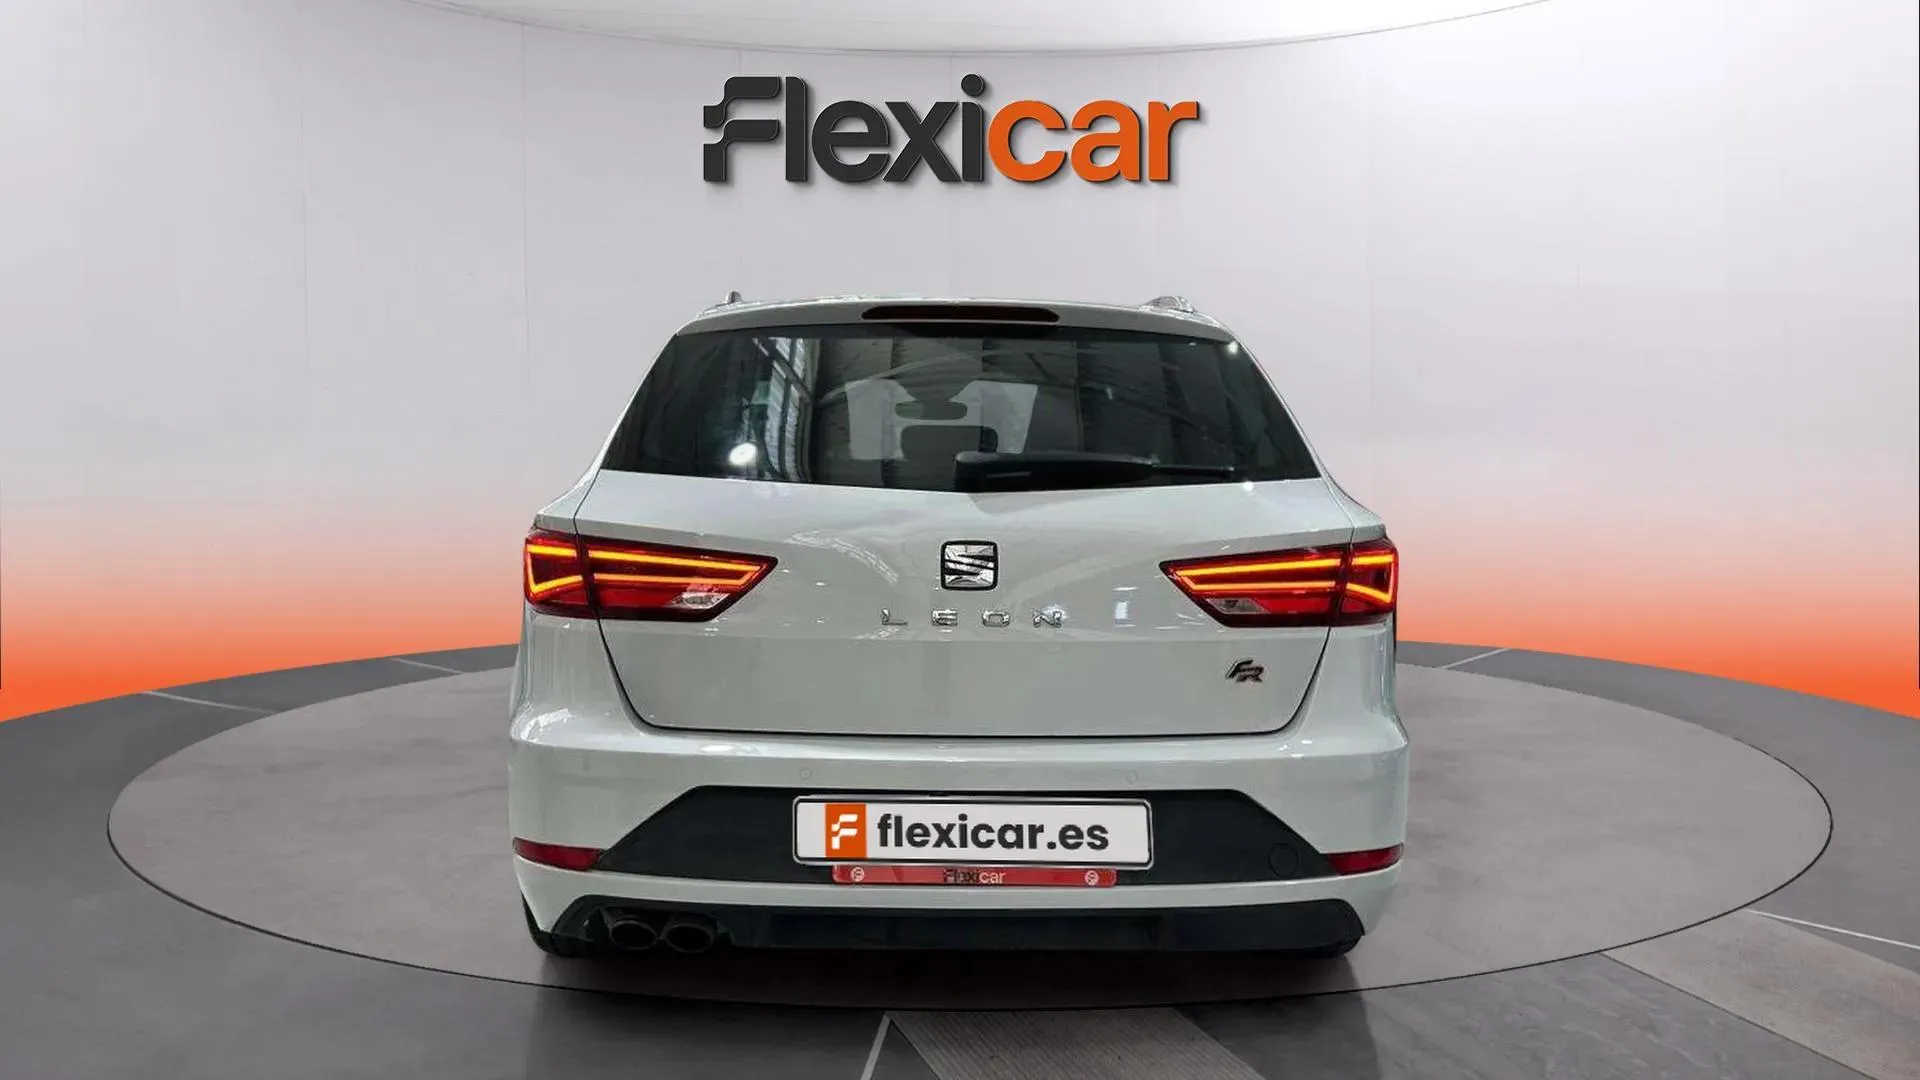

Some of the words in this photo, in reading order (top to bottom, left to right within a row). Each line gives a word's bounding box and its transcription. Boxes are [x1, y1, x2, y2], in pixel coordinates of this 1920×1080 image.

[703, 74, 1198, 183] Flexicar
[881, 608, 1063, 628] LEON
[1226, 658, 1264, 682] FR
[877, 813, 1109, 850] flexicar.es
